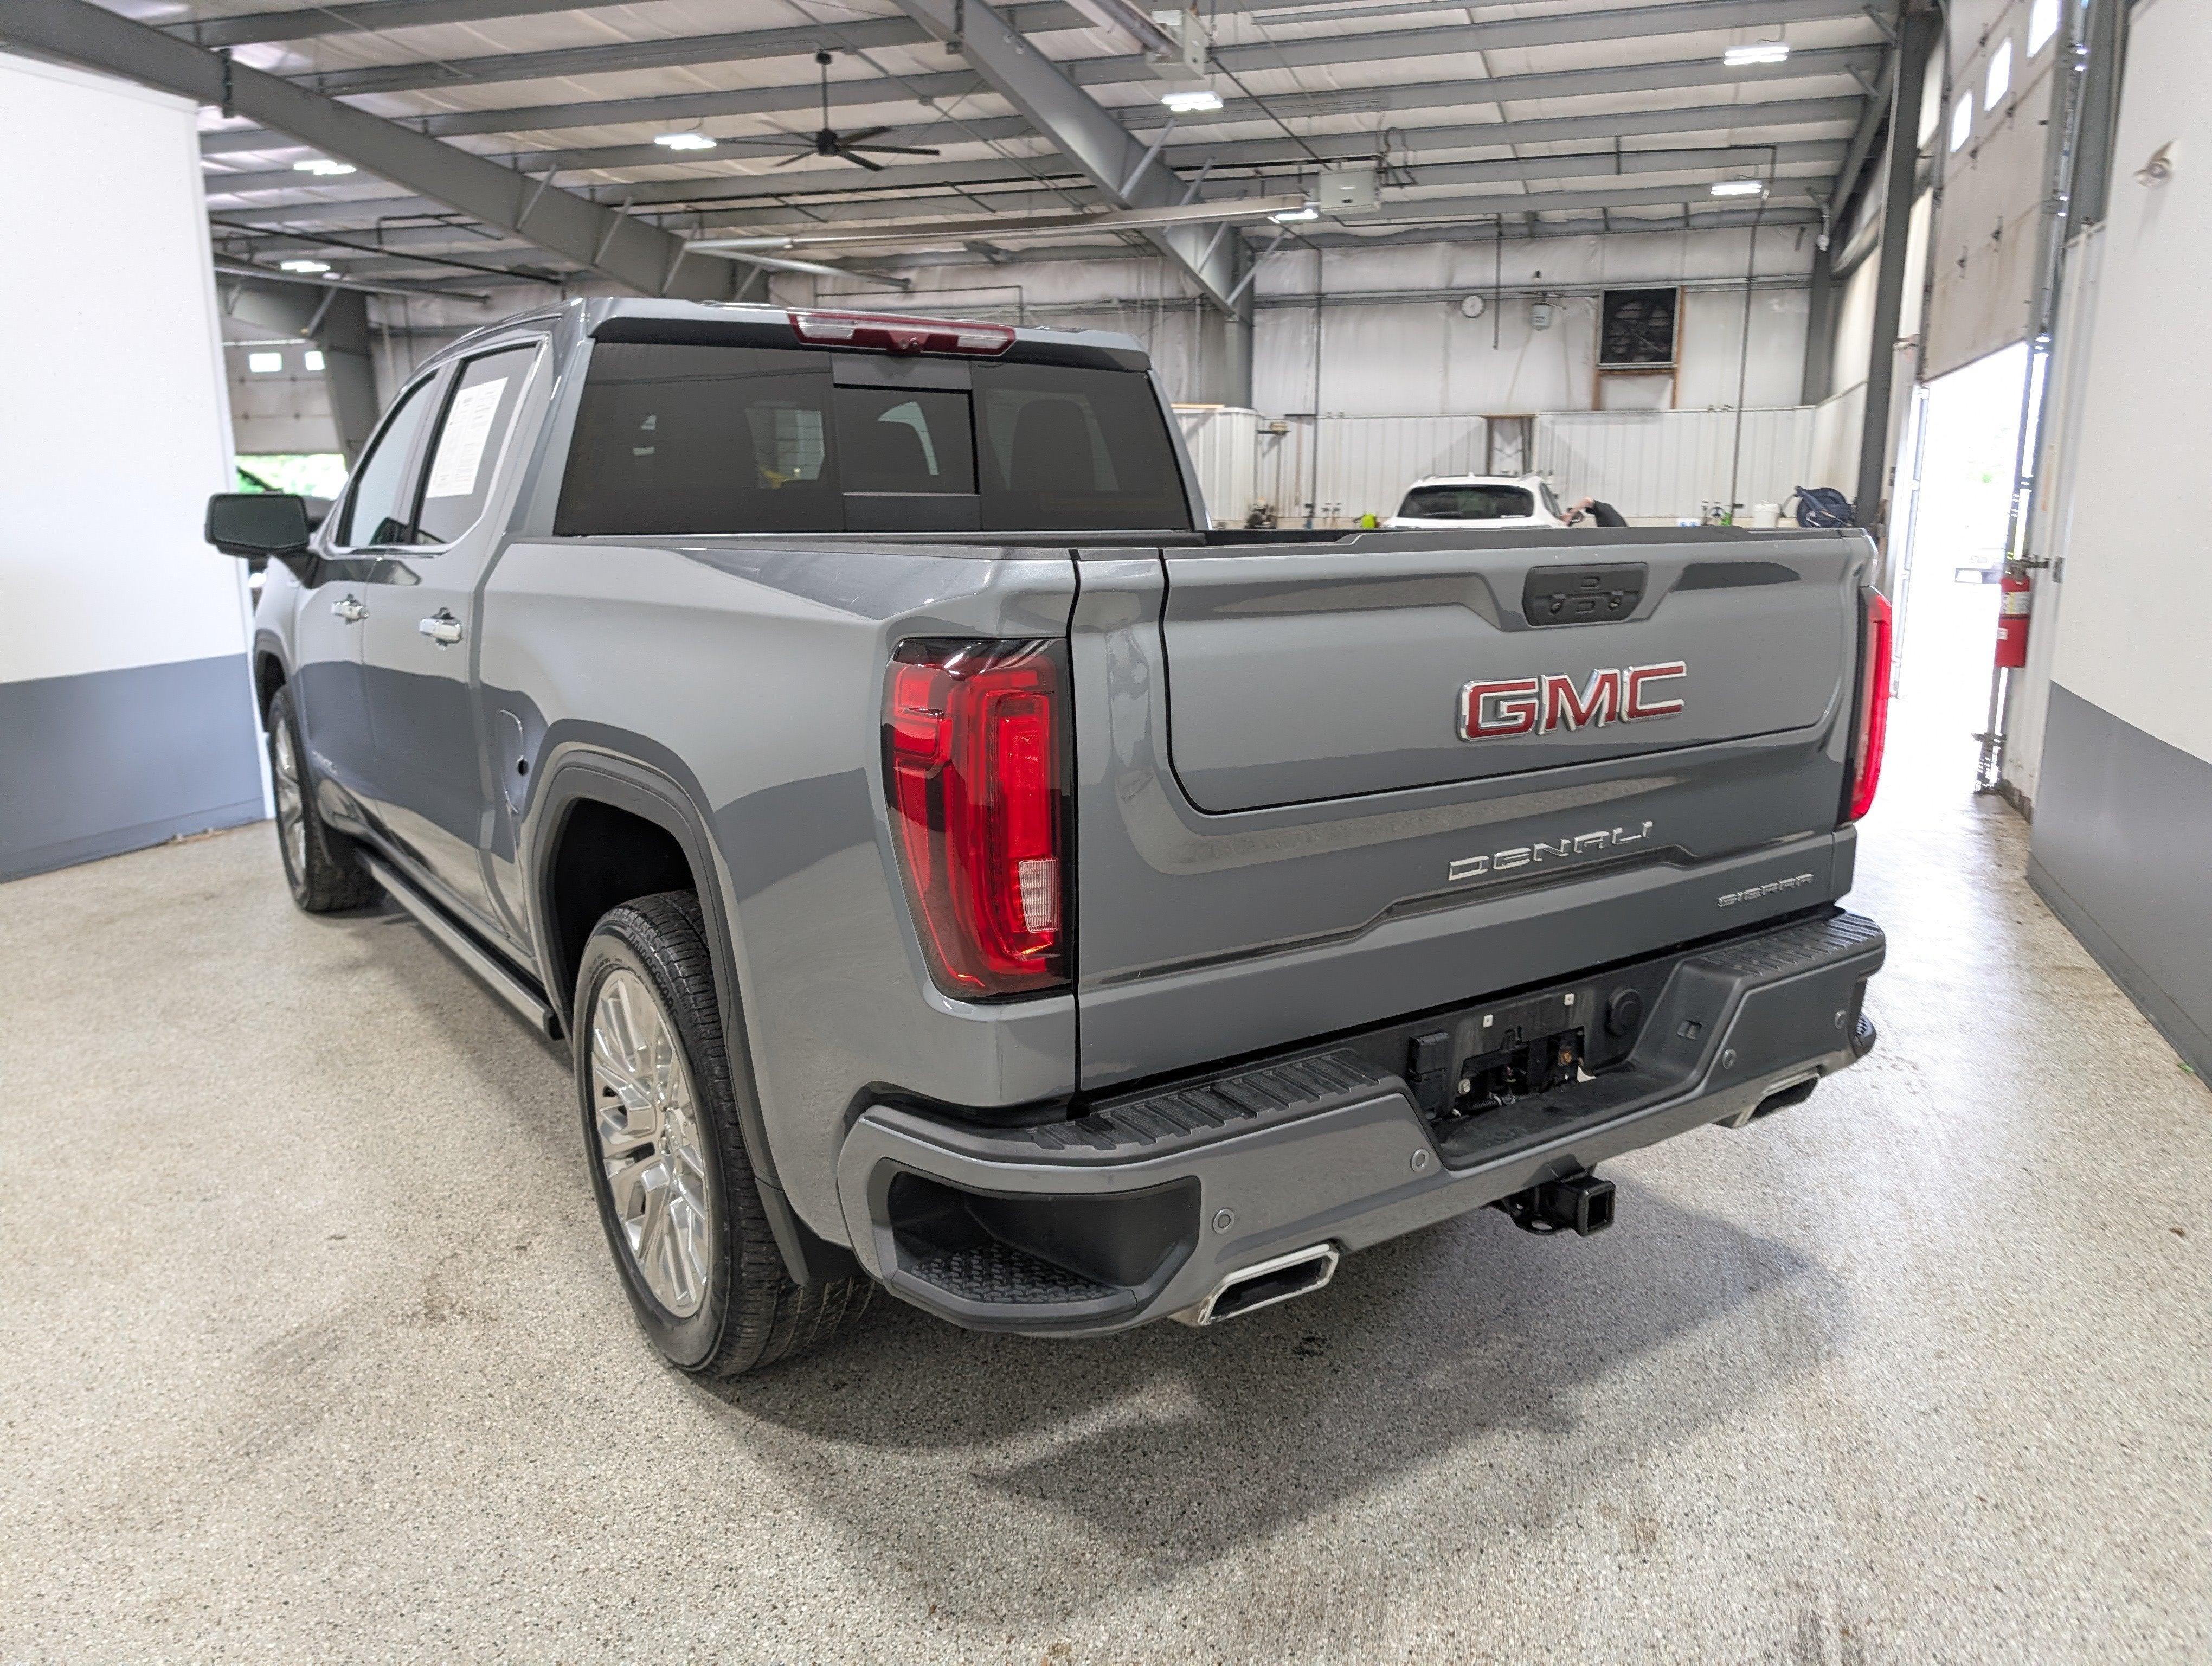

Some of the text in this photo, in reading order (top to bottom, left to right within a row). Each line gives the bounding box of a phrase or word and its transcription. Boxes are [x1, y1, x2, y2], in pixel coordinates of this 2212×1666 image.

[1458, 660, 1687, 742] GMC
[1448, 821, 1653, 881] DENALI
[1718, 873, 1814, 907] SIERRA
